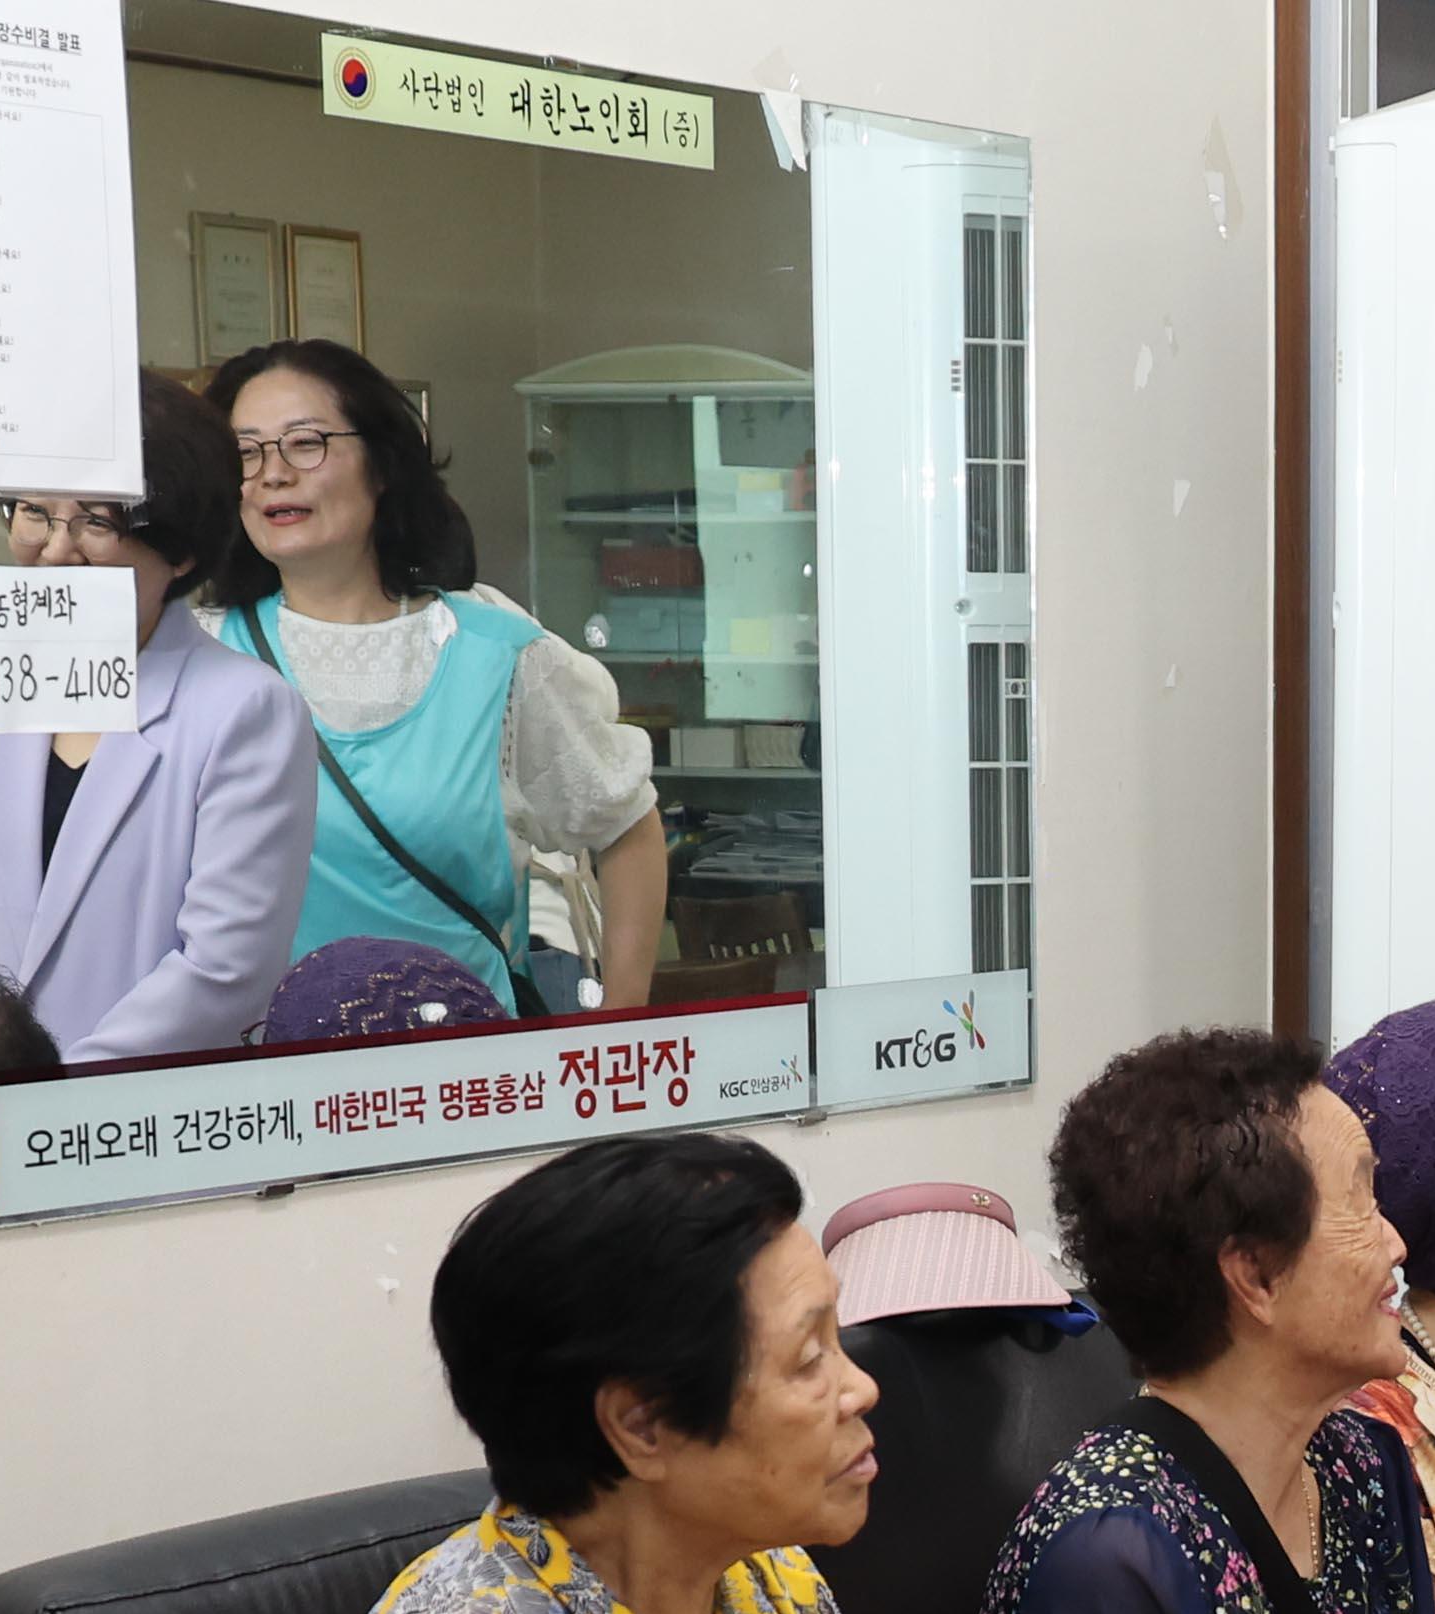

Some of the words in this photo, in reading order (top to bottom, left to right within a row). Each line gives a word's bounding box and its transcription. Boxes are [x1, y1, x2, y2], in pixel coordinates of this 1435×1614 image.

[57, 32, 82, 52] 발표
[399, 68, 484, 117] 사단법인
[510, 79, 649, 146] 대한노인회
[875, 1028, 958, 1071] KT&G
[24, 1115, 158, 1168] 오래오래
[173, 1099, 302, 1153] 건강하게,
[315, 1086, 427, 1135] 대한민국
[439, 1070, 545, 1121] 명품홍삼
[558, 1037, 696, 1119] 정관장
[719, 1079, 749, 1099] KGC
[750, 1074, 791, 1095] 인삼공사
